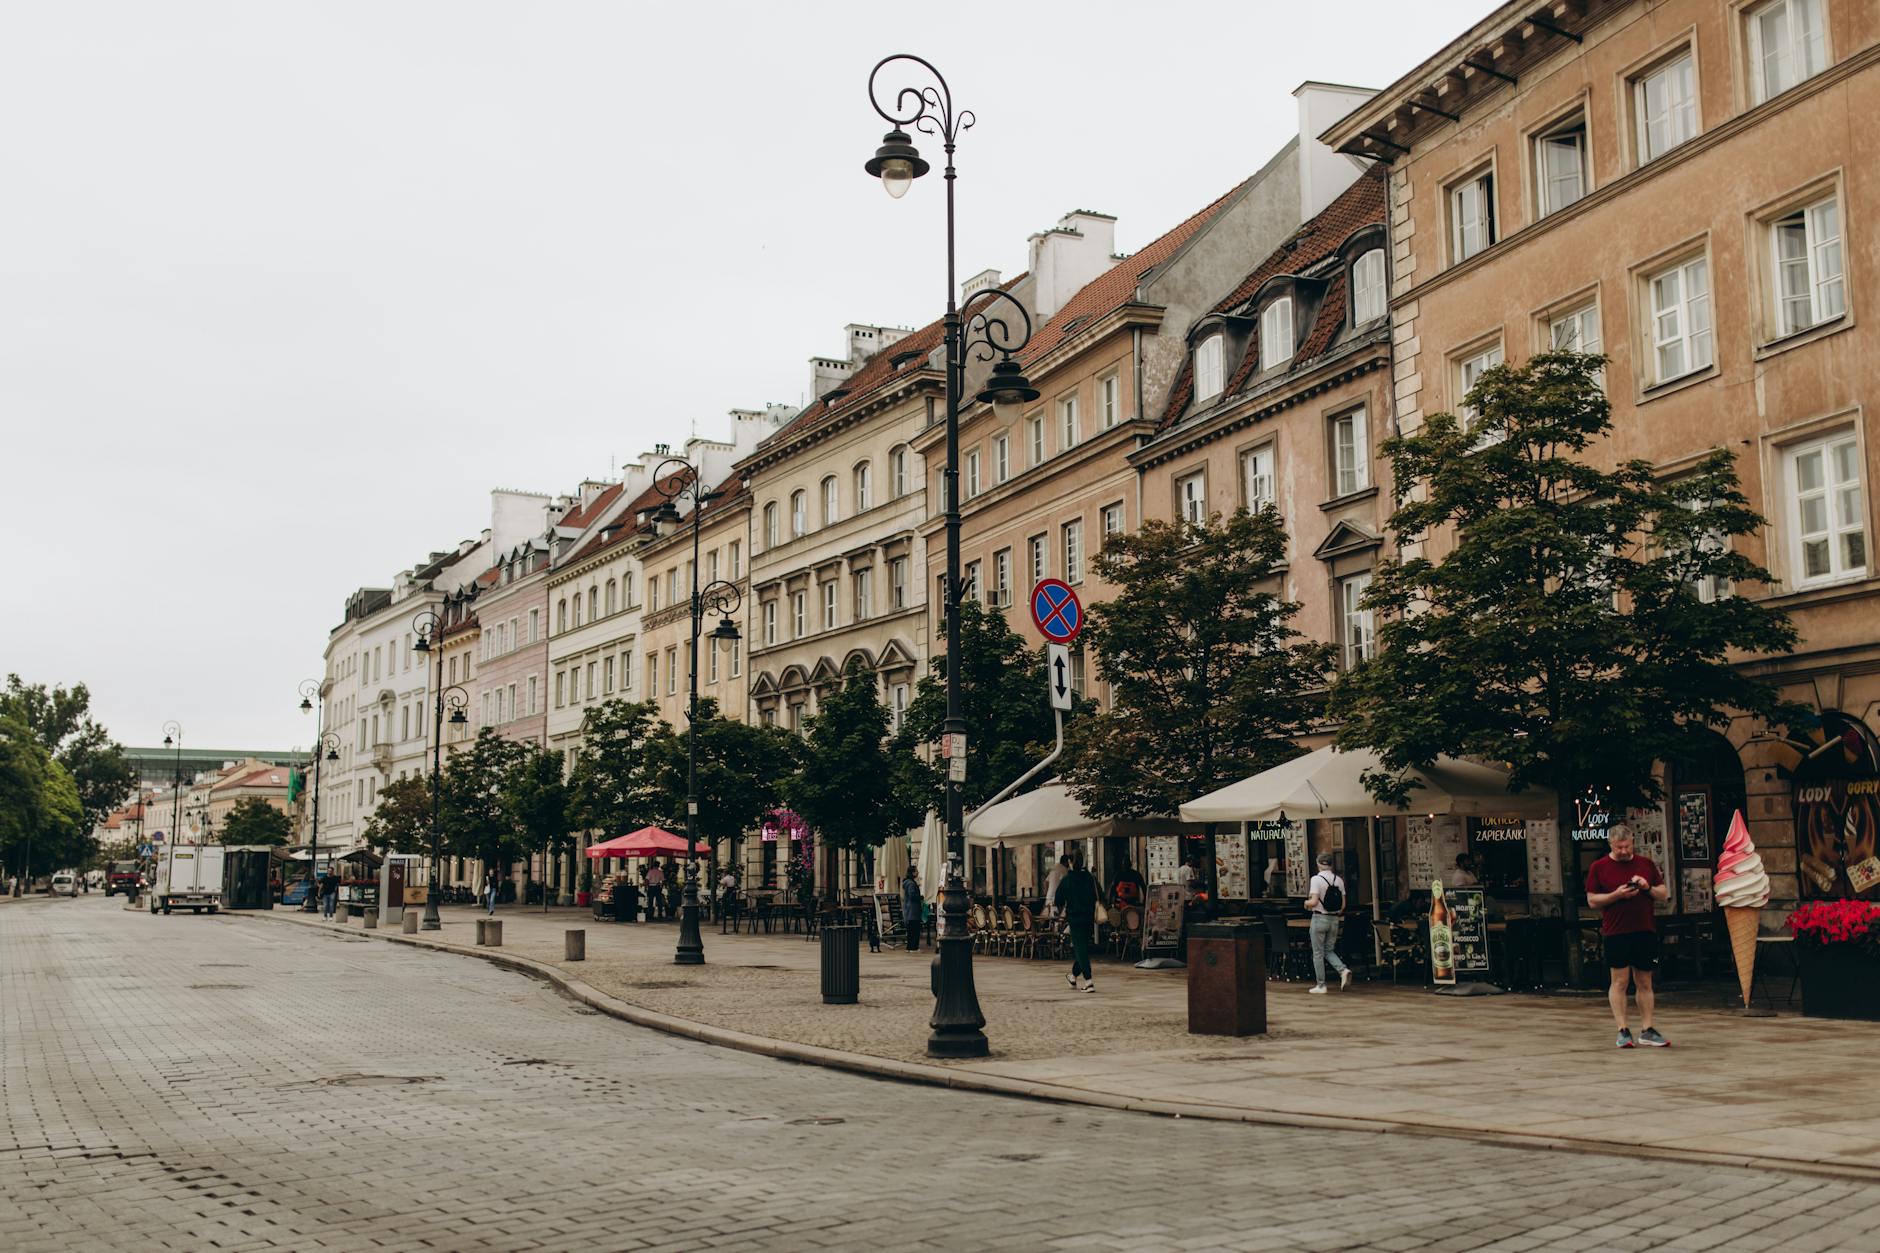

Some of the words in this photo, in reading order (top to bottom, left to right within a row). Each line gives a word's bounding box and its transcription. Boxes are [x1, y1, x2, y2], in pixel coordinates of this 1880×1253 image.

[1847, 780, 1880, 794] GOFRY
[1798, 786, 1832, 803] LODY
[1588, 813, 1610, 824] LODY
[1475, 828, 1527, 841] ZAPIEKANKI
